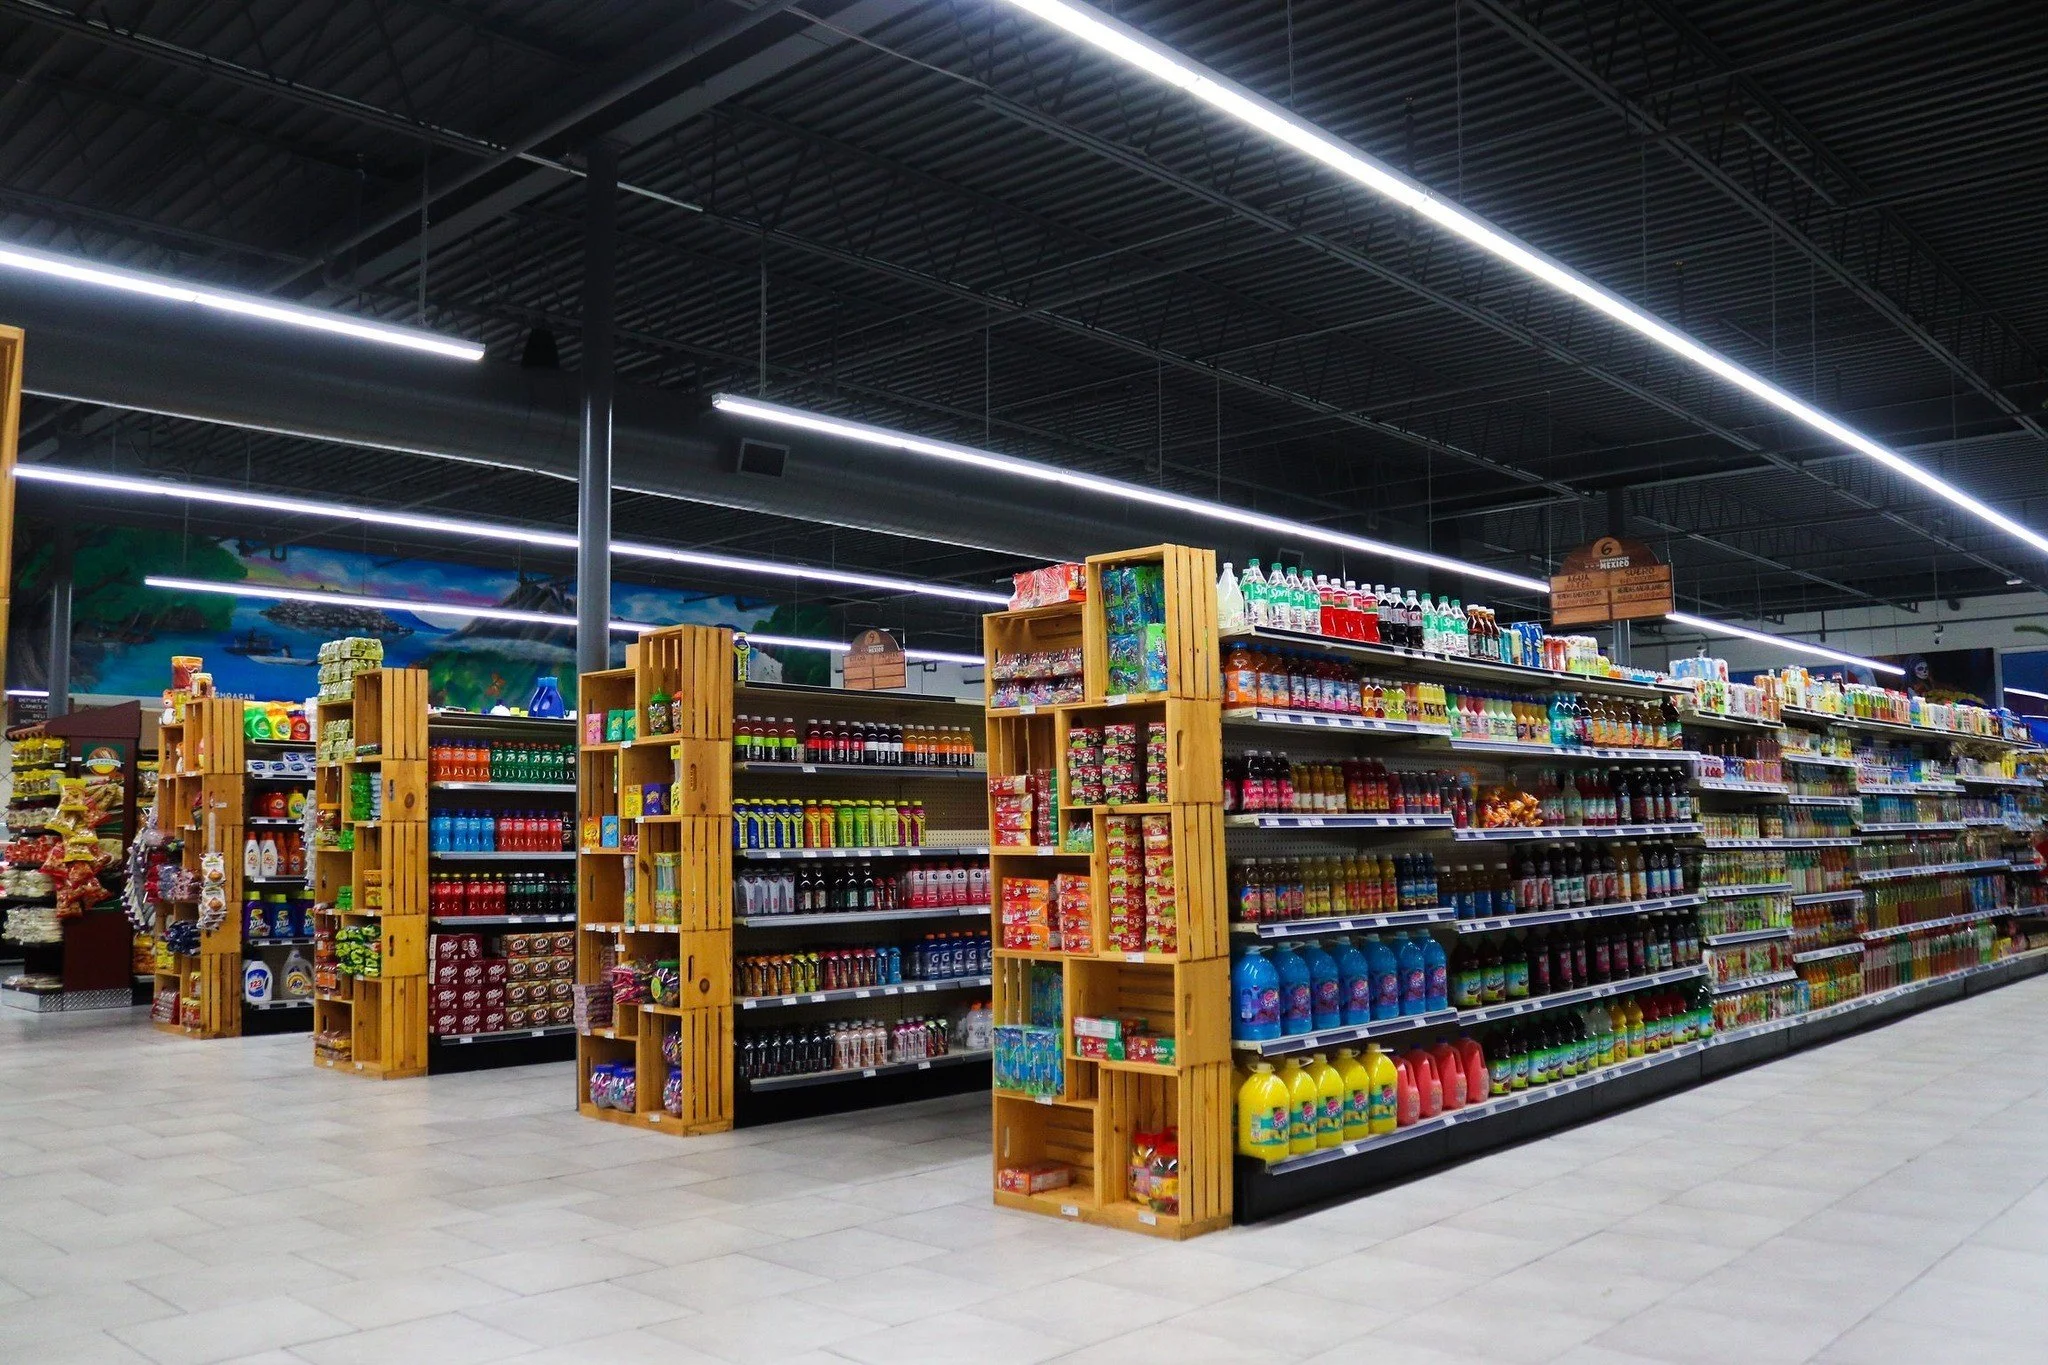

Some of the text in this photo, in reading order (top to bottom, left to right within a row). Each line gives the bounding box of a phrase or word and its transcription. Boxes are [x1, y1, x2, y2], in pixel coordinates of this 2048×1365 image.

[1602, 542, 1612, 555] 6
[869, 632, 875, 643] 9
[932, 953, 939, 963] G
[942, 953, 949, 962] G
[955, 951, 962, 960] G
[969, 950, 976, 959] G
